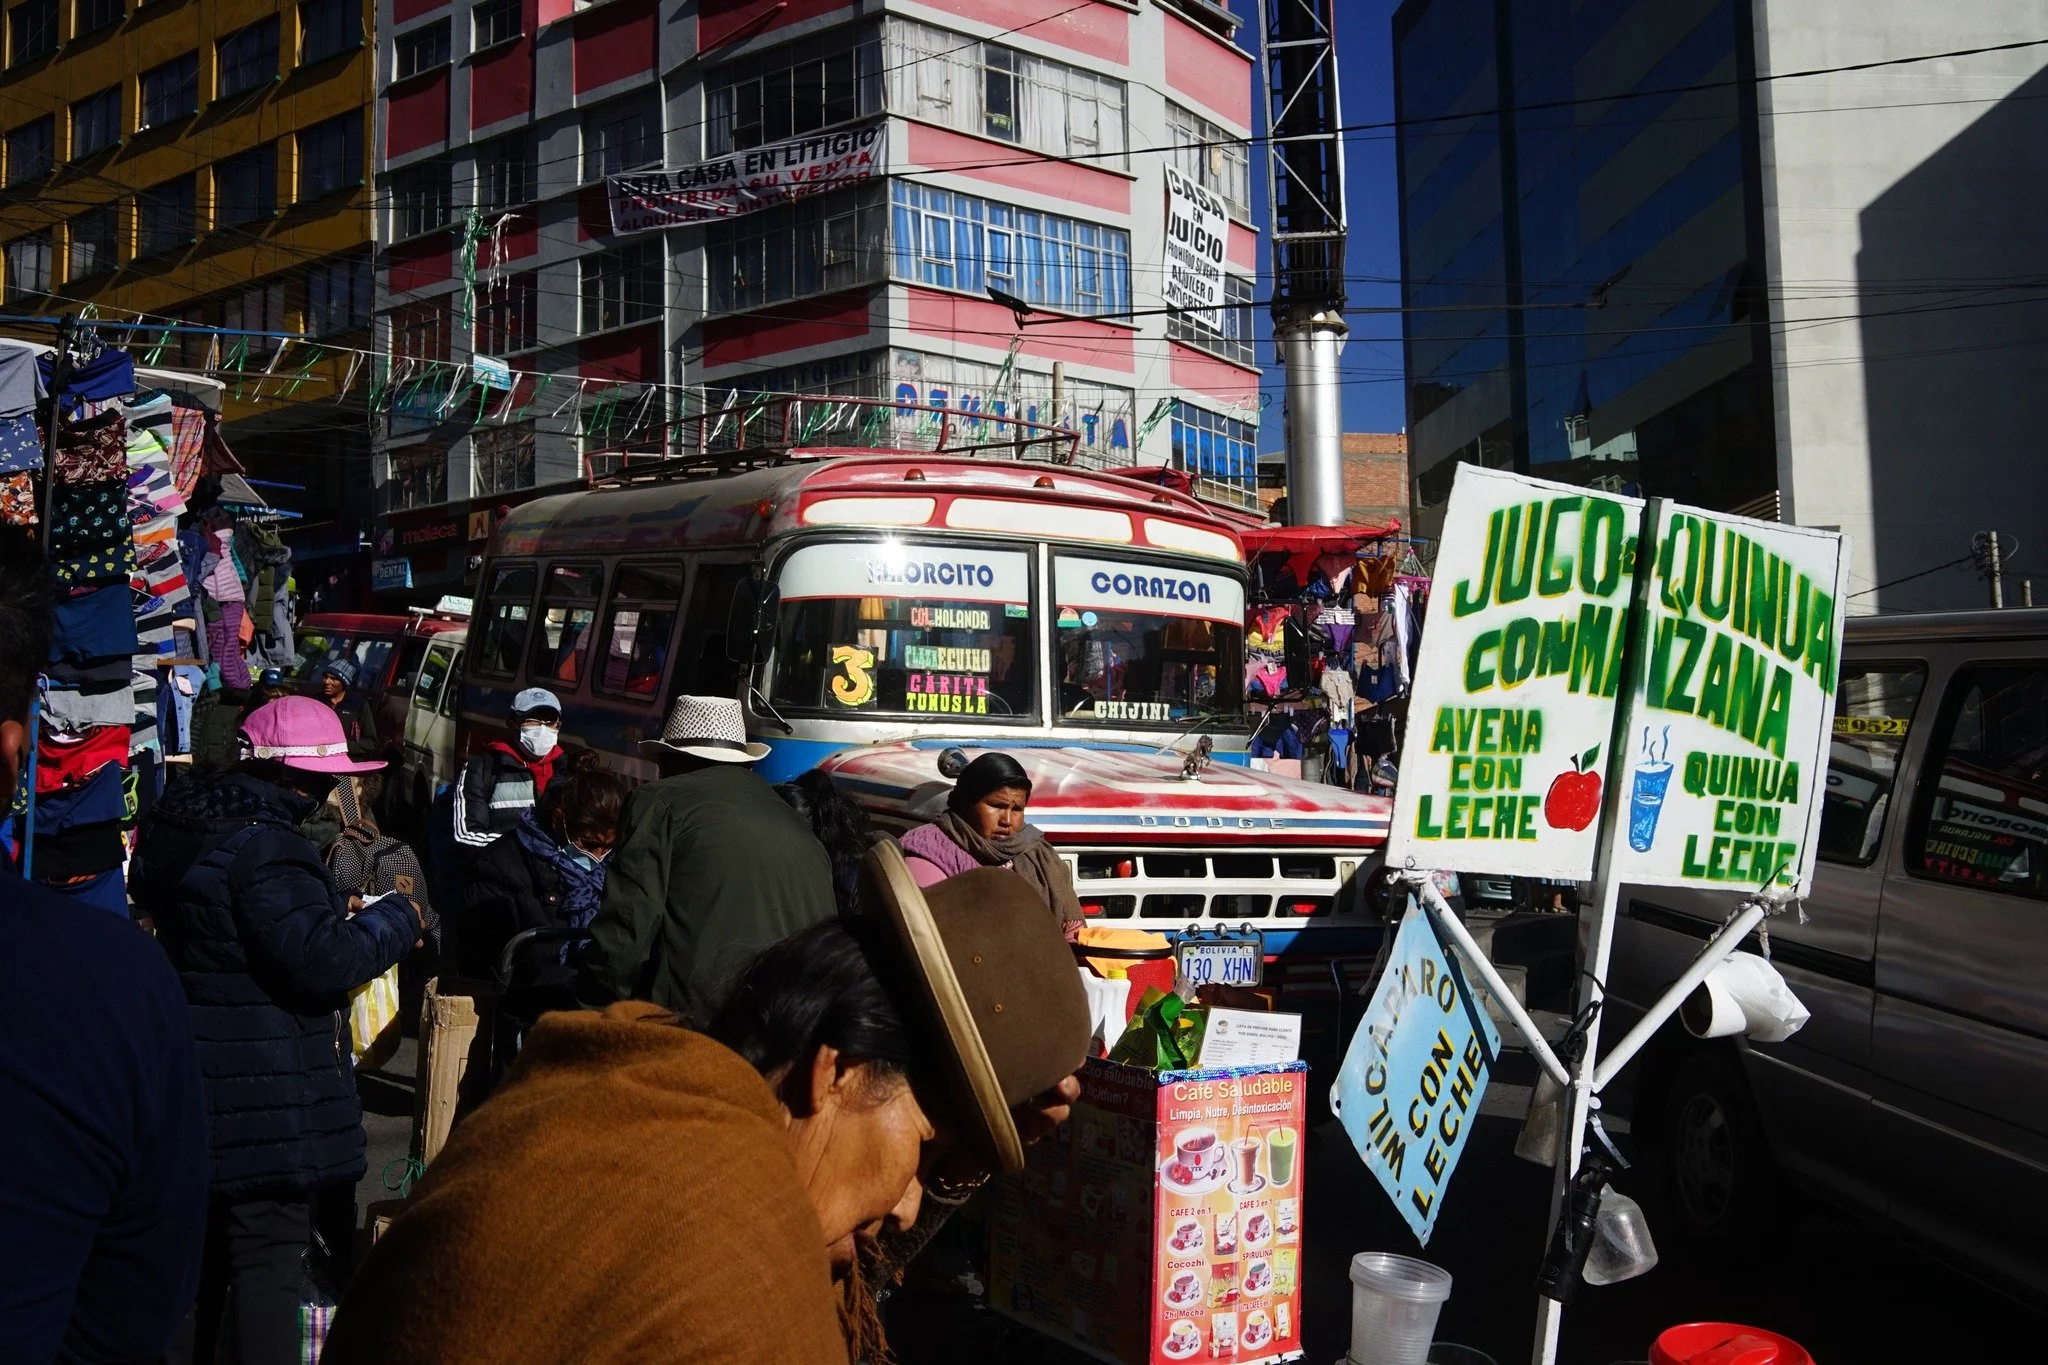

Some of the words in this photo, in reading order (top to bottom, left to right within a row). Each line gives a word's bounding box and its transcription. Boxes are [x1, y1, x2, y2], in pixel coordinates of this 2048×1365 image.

[619, 173, 671, 197] ESTA
[677, 159, 737, 190] CASA
[745, 149, 776, 176] EN
[784, 127, 878, 167] LITIGIO
[748, 172, 779, 190] SU
[790, 150, 873, 182] VENTA
[1168, 168, 1225, 221] CASA
[620, 203, 709, 231] ALQUILER
[716, 205, 728, 217] O
[1192, 207, 1204, 225] EN
[1168, 211, 1223, 264] JUICIO
[1208, 286, 1214, 303] O
[379, 564, 407, 579] DENTAL
[1451, 496, 1625, 620] JUGO
[1659, 513, 1837, 697] QUINUA
[934, 608, 989, 629] HOLANDA
[1463, 616, 1577, 695] CON
[831, 644, 875, 708] 3
[1094, 700, 1170, 720] CHIJINI
[1429, 706, 1543, 755] AVENA
[1851, 719, 1898, 734] 952
[1449, 754, 1523, 793] CON
[1682, 751, 1800, 804] QUINUA
[1140, 815, 1284, 830] DODGE
[1414, 794, 1541, 841] LECHE
[1713, 799, 1782, 837] CON
[1681, 834, 1797, 886] LECHE
[1185, 957, 1212, 981] 130
[1222, 957, 1253, 981] XHN
[1103, 1069, 1155, 1090] saludable
[1174, 1082, 1214, 1102] Café
[1218, 1077, 1293, 1099] Saludable
[1408, 1027, 1456, 1140] CON
[1170, 1108, 1204, 1122] Limpia,
[1205, 1105, 1230, 1119] Nutre,
[1232, 1099, 1292, 1117] Desintoxicación
[1411, 1030, 1484, 1222] LECHE
[1170, 1207, 1189, 1218] CAFE
[1190, 1207, 1196, 1216] 2
[1240, 1200, 1255, 1210] CAFE
[1167, 1258, 1205, 1269] Cocozhi
[1242, 1249, 1273, 1261] SPIRULINA
[1164, 1310, 1178, 1319] Zhi
[1179, 1309, 1204, 1318] Mocha
